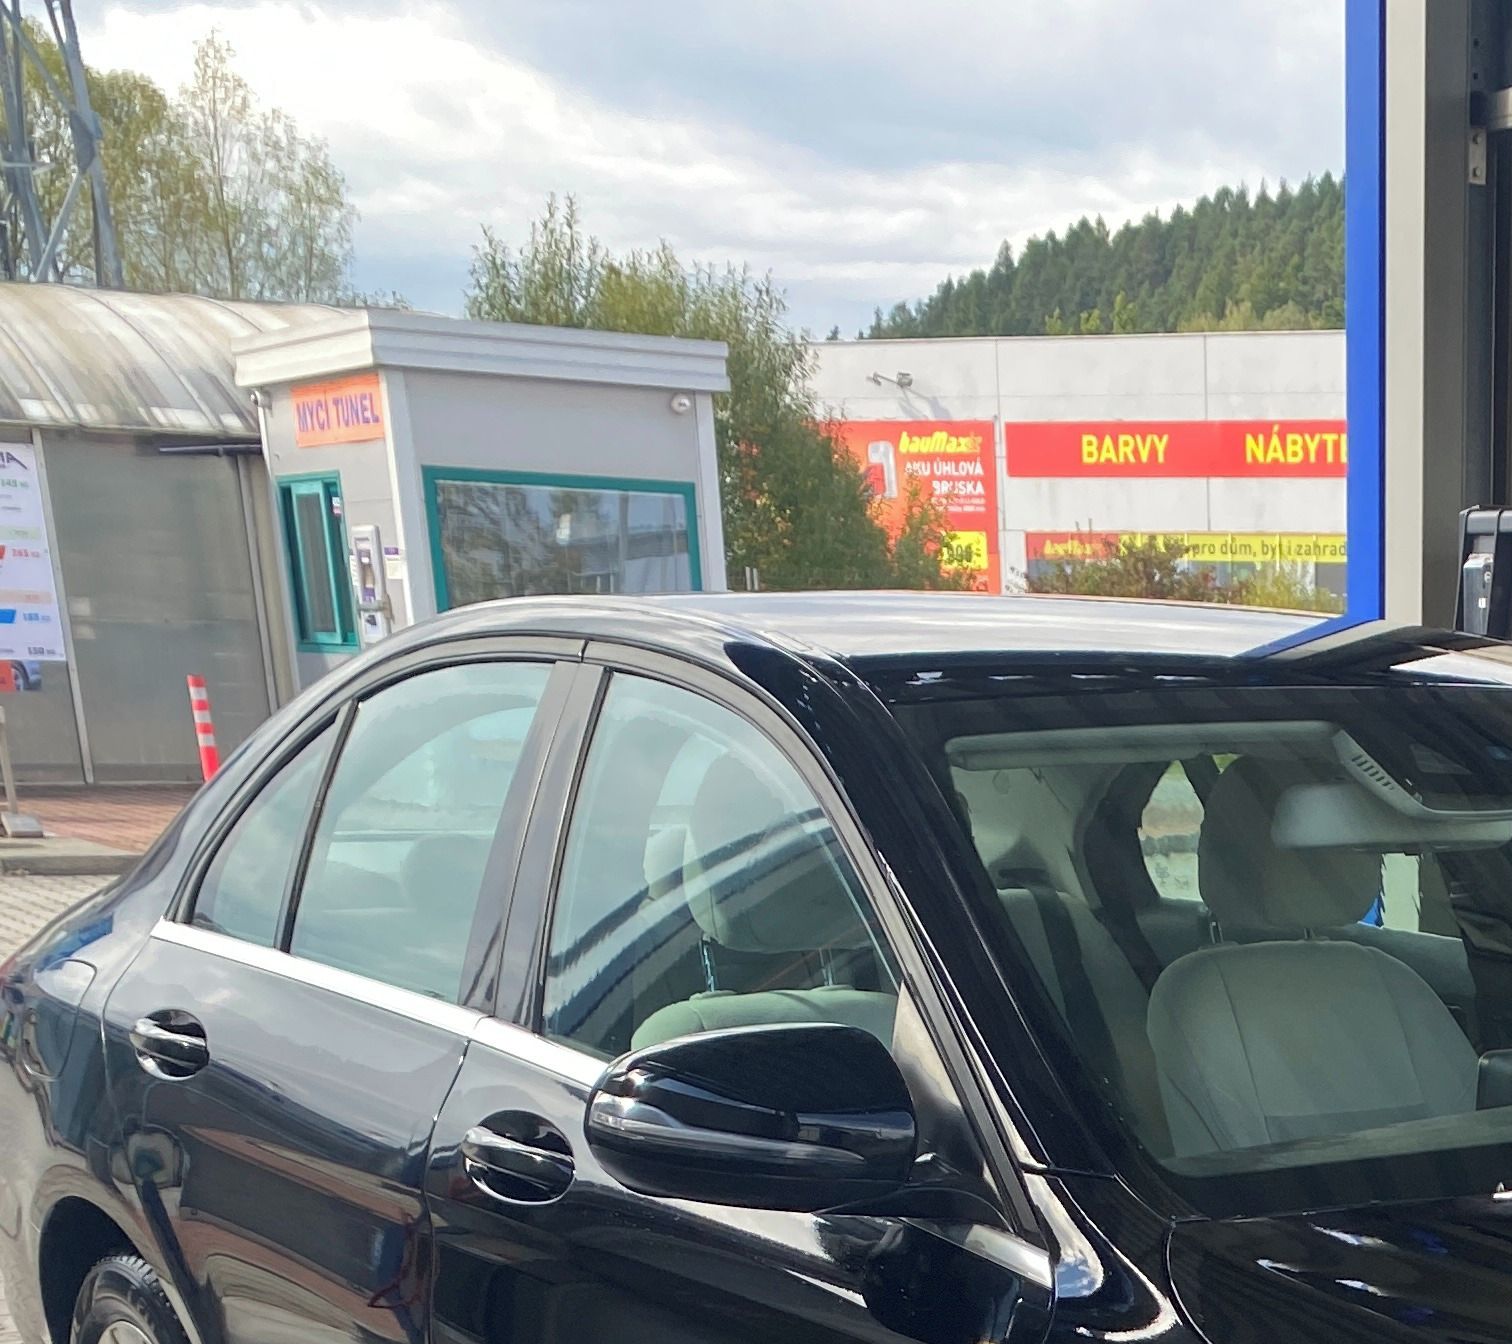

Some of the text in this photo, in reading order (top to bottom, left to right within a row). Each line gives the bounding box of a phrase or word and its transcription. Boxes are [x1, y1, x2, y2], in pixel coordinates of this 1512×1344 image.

[332, 392, 380, 428] TUNEL
[1081, 433, 1169, 464] BARVY
[933, 456, 985, 477] ÚHLOVÁ
[1192, 542, 1216, 558] pro
[1220, 537, 1257, 558] dům,
